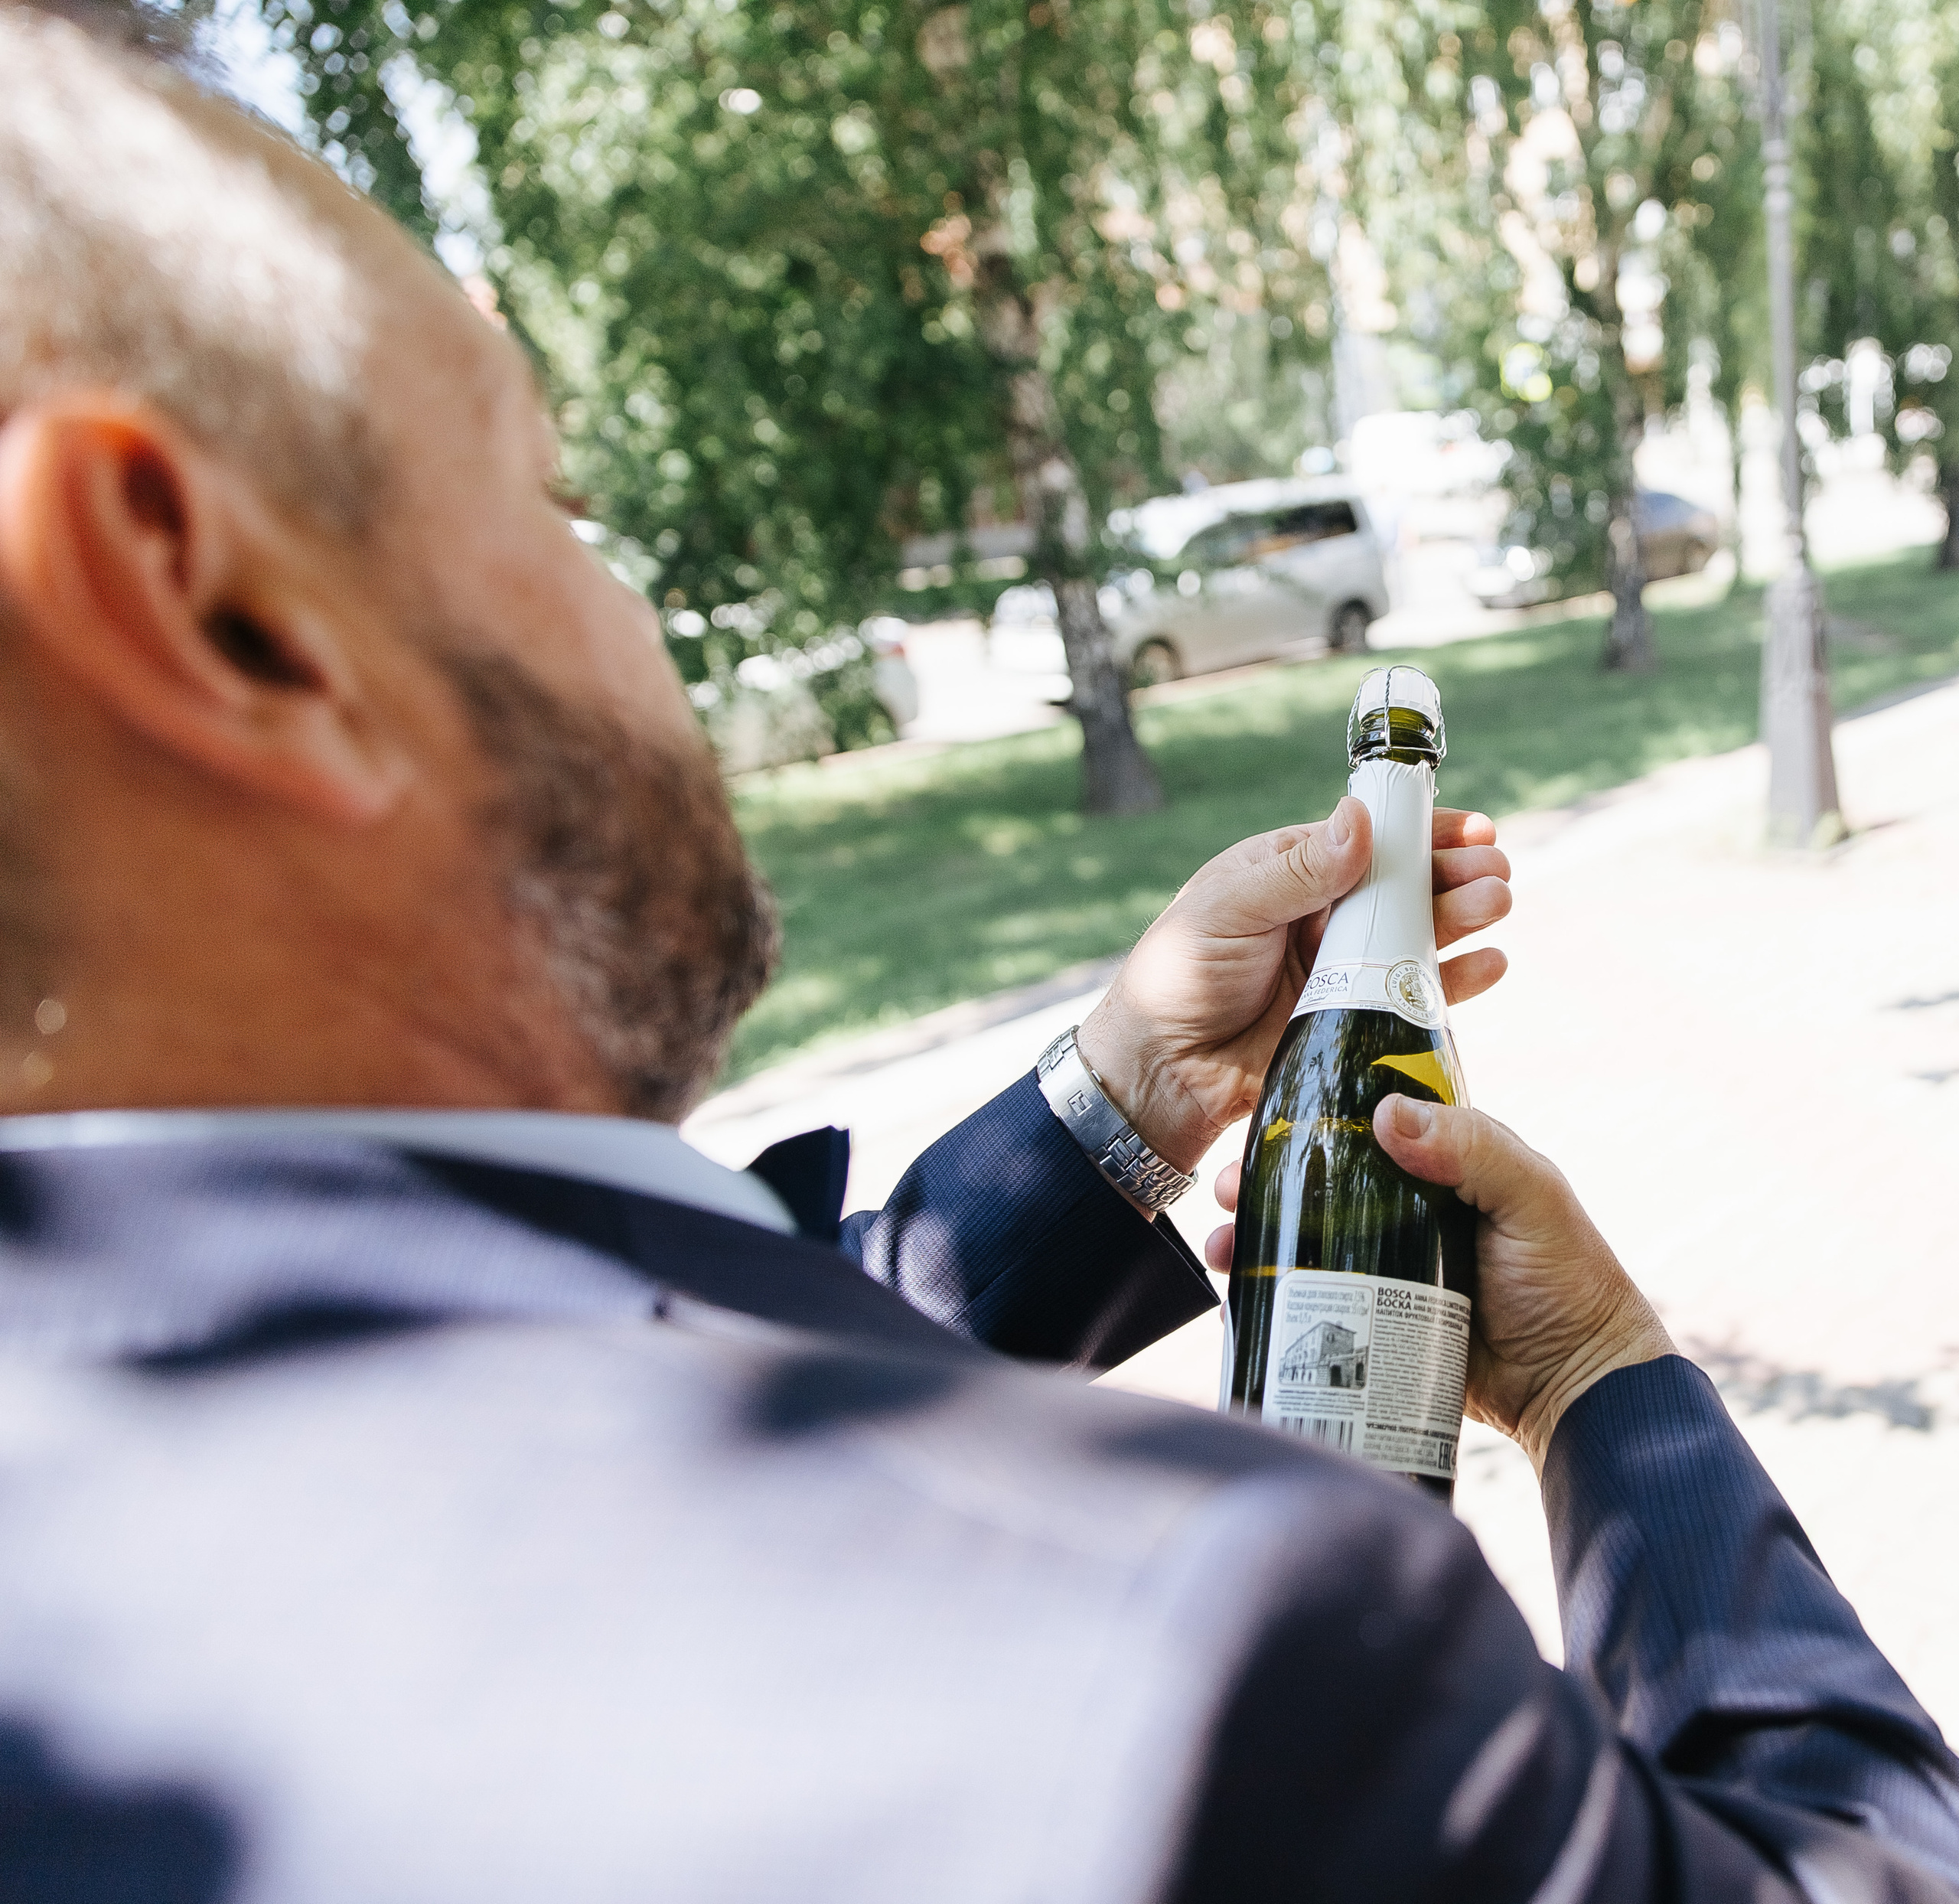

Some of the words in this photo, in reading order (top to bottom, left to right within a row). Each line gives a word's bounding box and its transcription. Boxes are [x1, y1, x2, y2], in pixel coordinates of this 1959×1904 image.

[1392, 970, 1403, 989] LUIGI
[1404, 967, 1426, 978] BOSCA
[1314, 986, 1348, 996] FEDERICA
[1397, 997, 1418, 1016] ANNO
[1377, 1286, 1412, 1300] BOSCA
[1377, 1296, 1412, 1311] БОСКА
